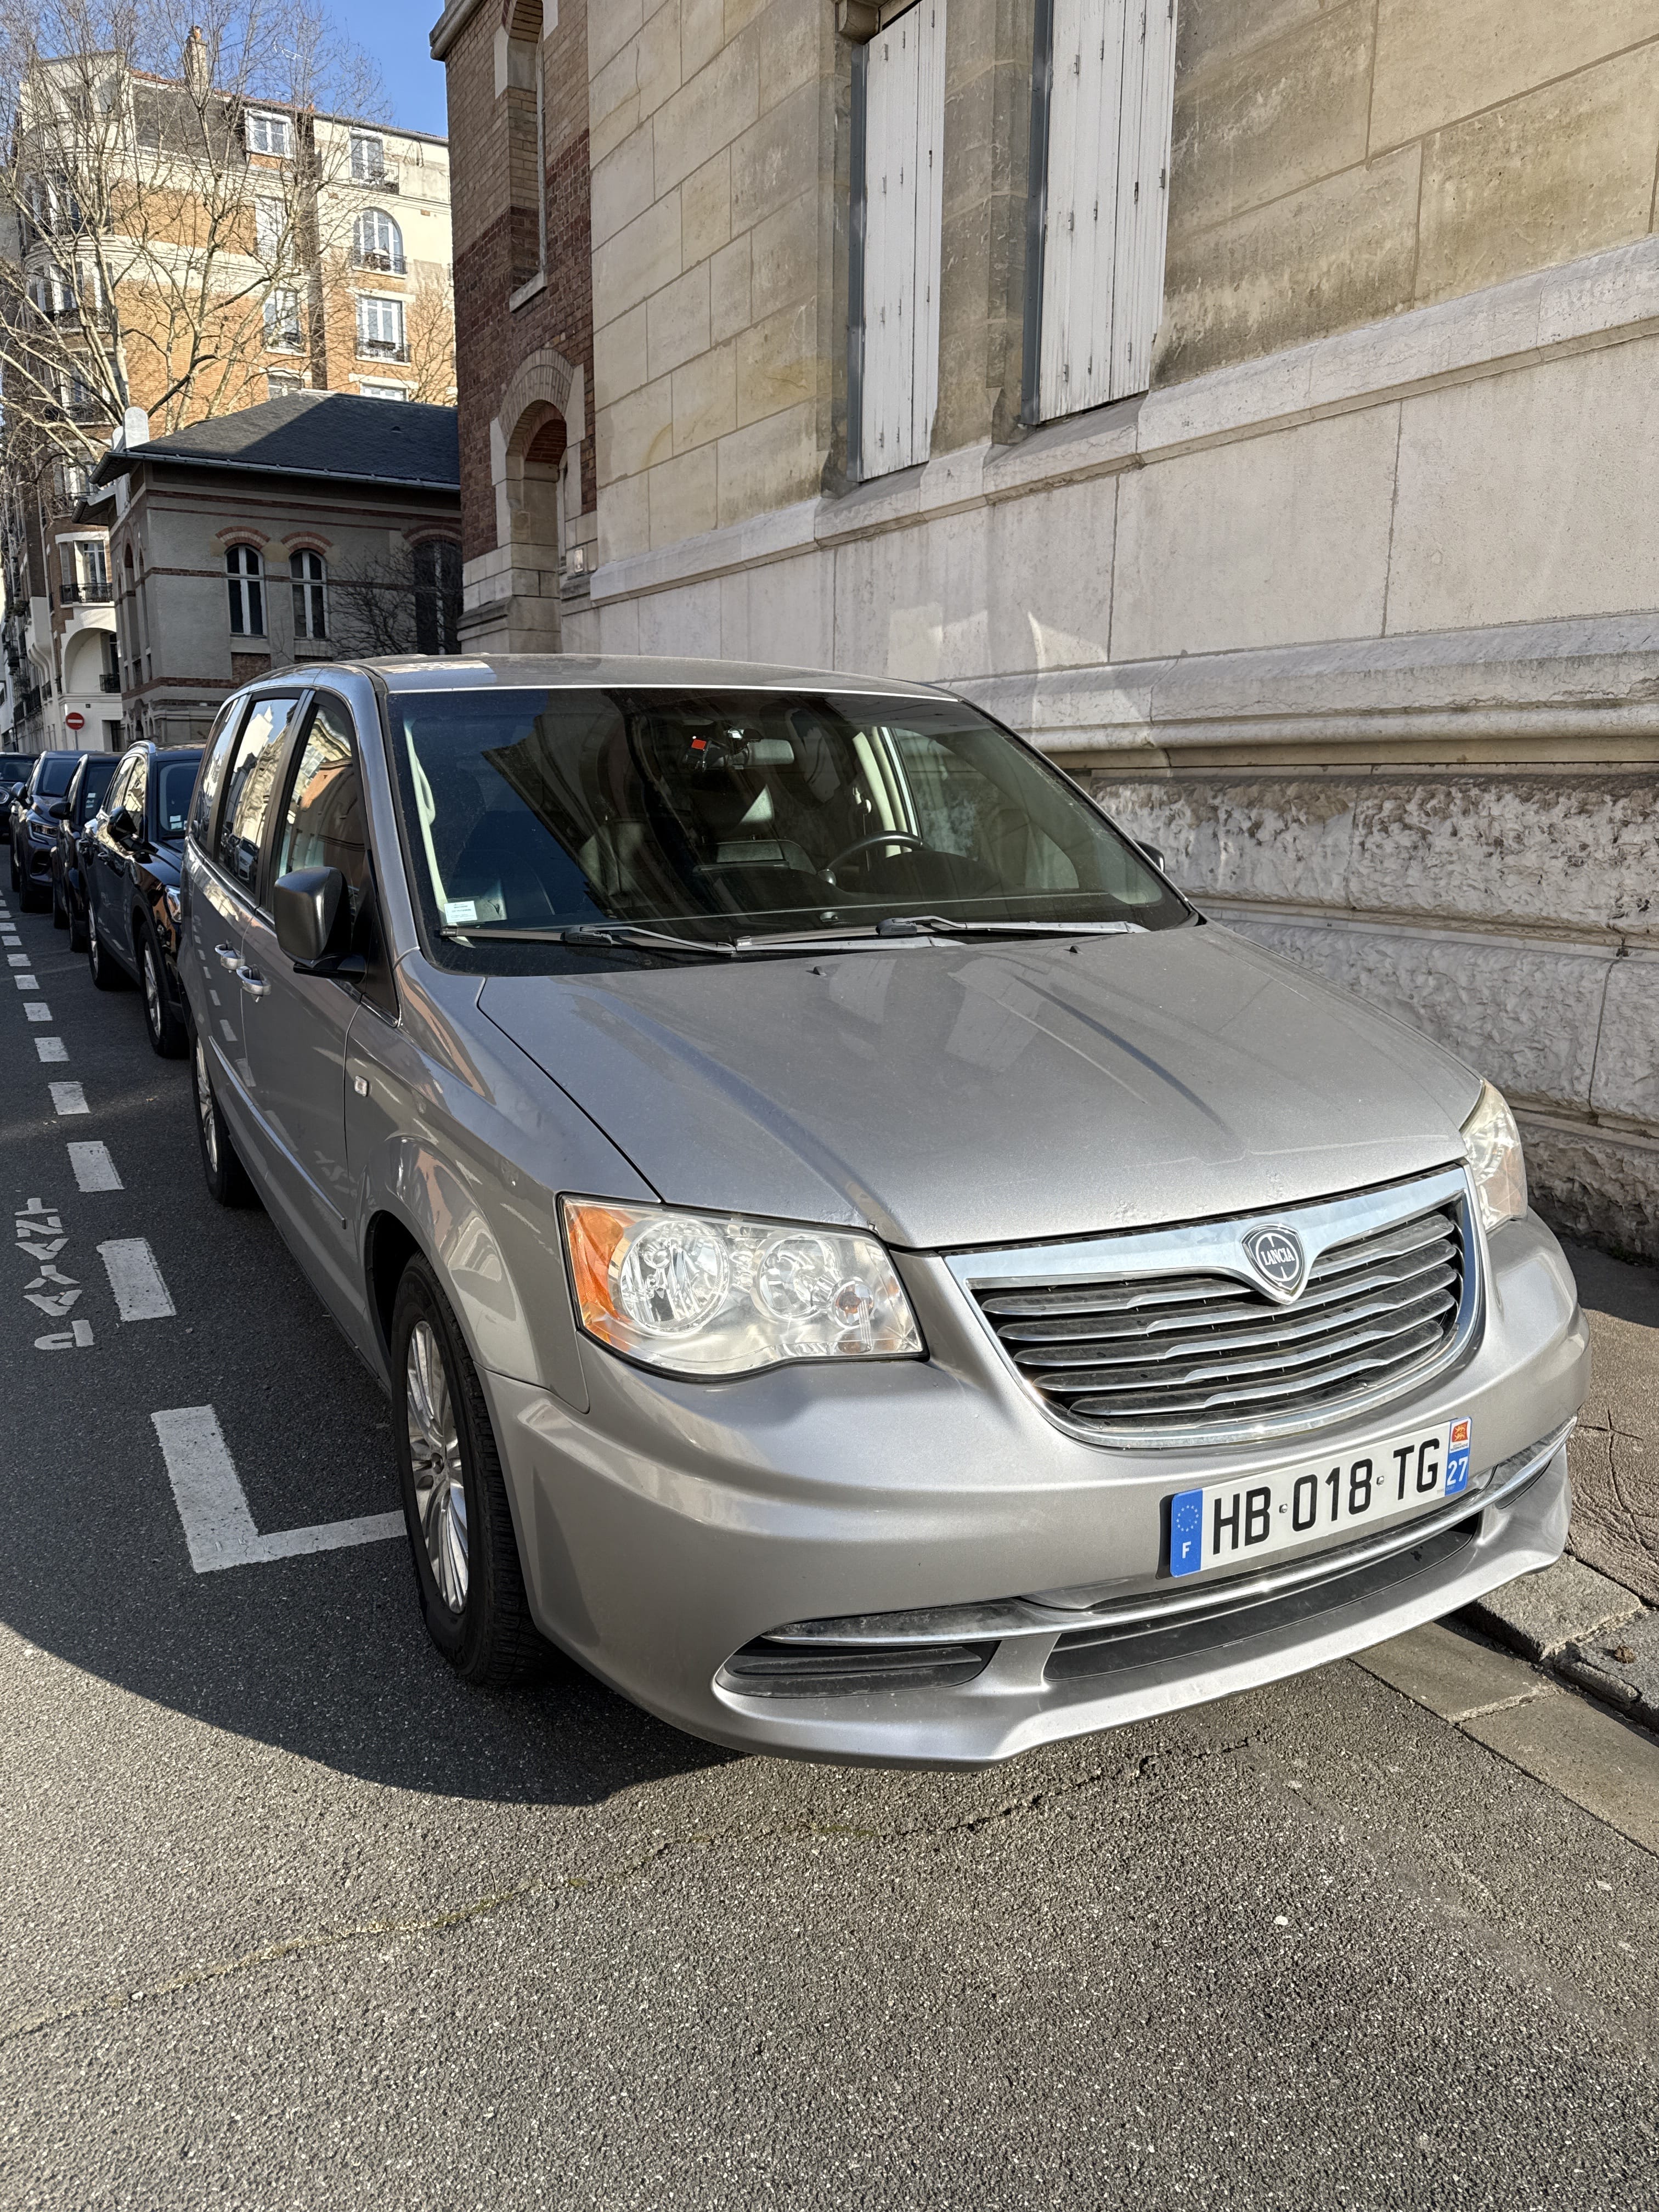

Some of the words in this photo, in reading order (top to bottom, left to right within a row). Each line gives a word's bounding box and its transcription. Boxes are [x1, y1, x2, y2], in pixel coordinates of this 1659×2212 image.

[1261, 1247, 1295, 1266] LANCIA
[14, 1198, 95, 1350] PAYANT
[1447, 1455, 1468, 1486] 27
[1213, 1487, 1271, 1555] HB
[1293, 1458, 1373, 1532] 018
[1393, 1438, 1440, 1500] TG
[1182, 1541, 1192, 1559] F
